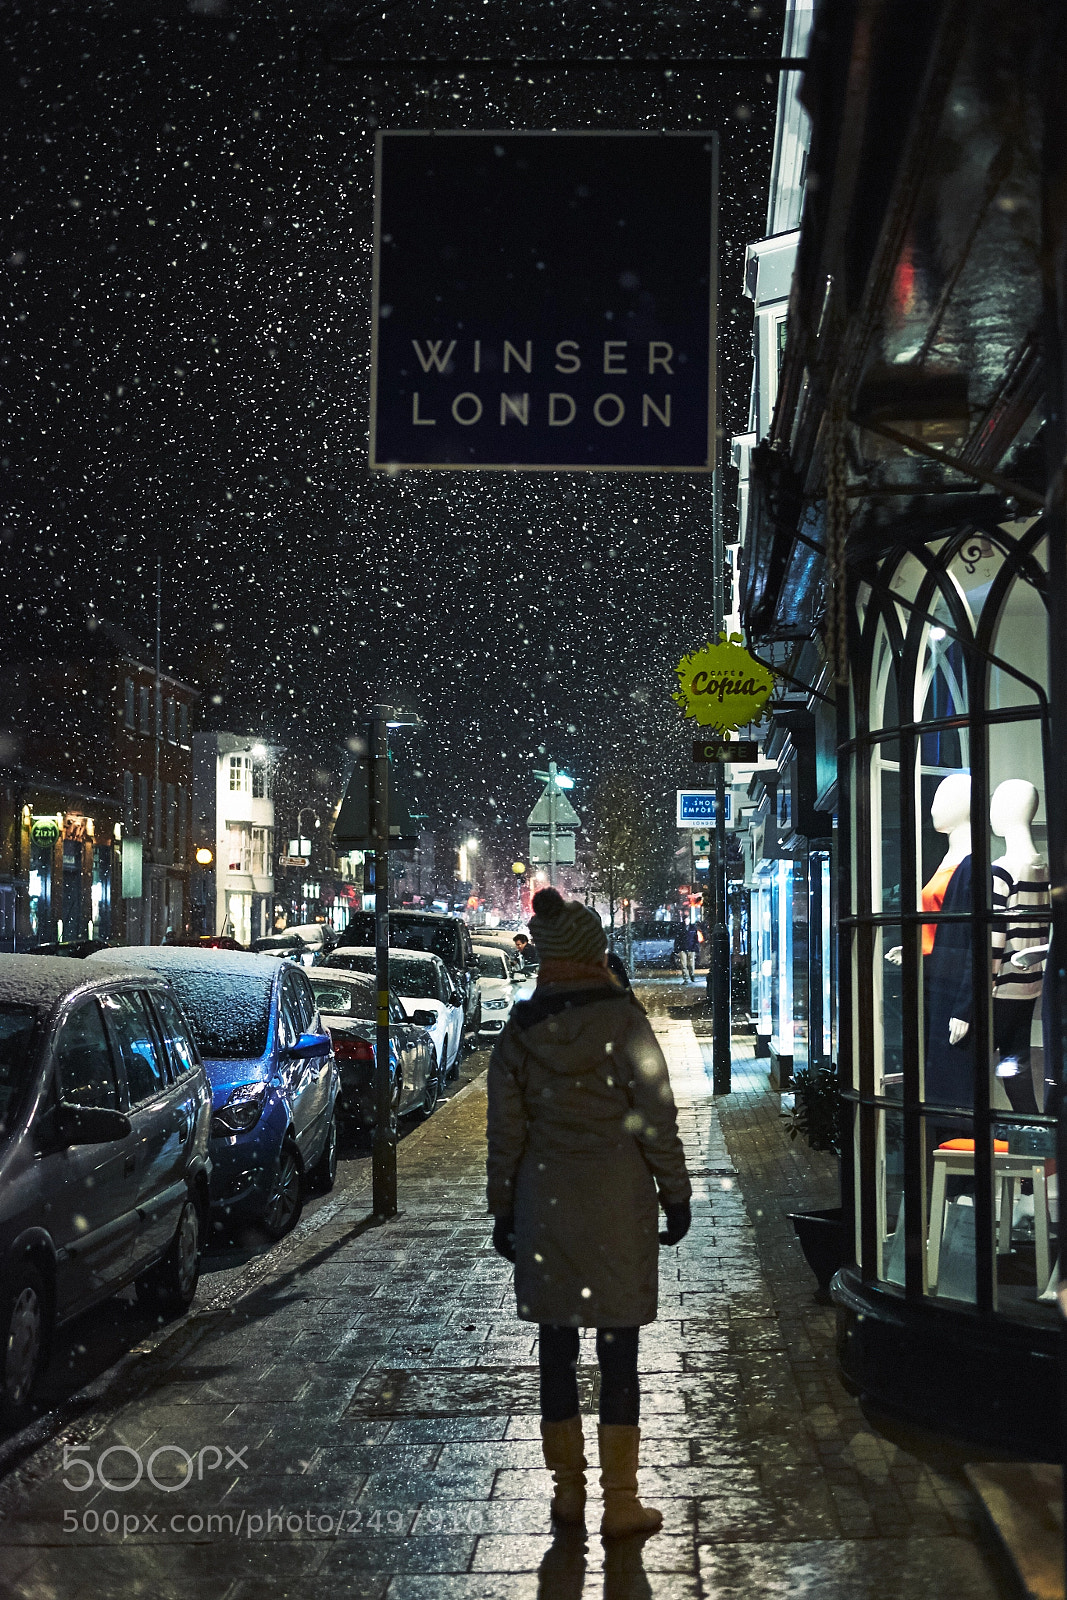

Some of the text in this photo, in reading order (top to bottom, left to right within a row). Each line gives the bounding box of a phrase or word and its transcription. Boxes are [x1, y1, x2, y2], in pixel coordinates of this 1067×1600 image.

[412, 340, 674, 375] WINSER
[412, 391, 672, 428] LONDON
[691, 671, 767, 702] Copia
[703, 745, 748, 758] CAFE
